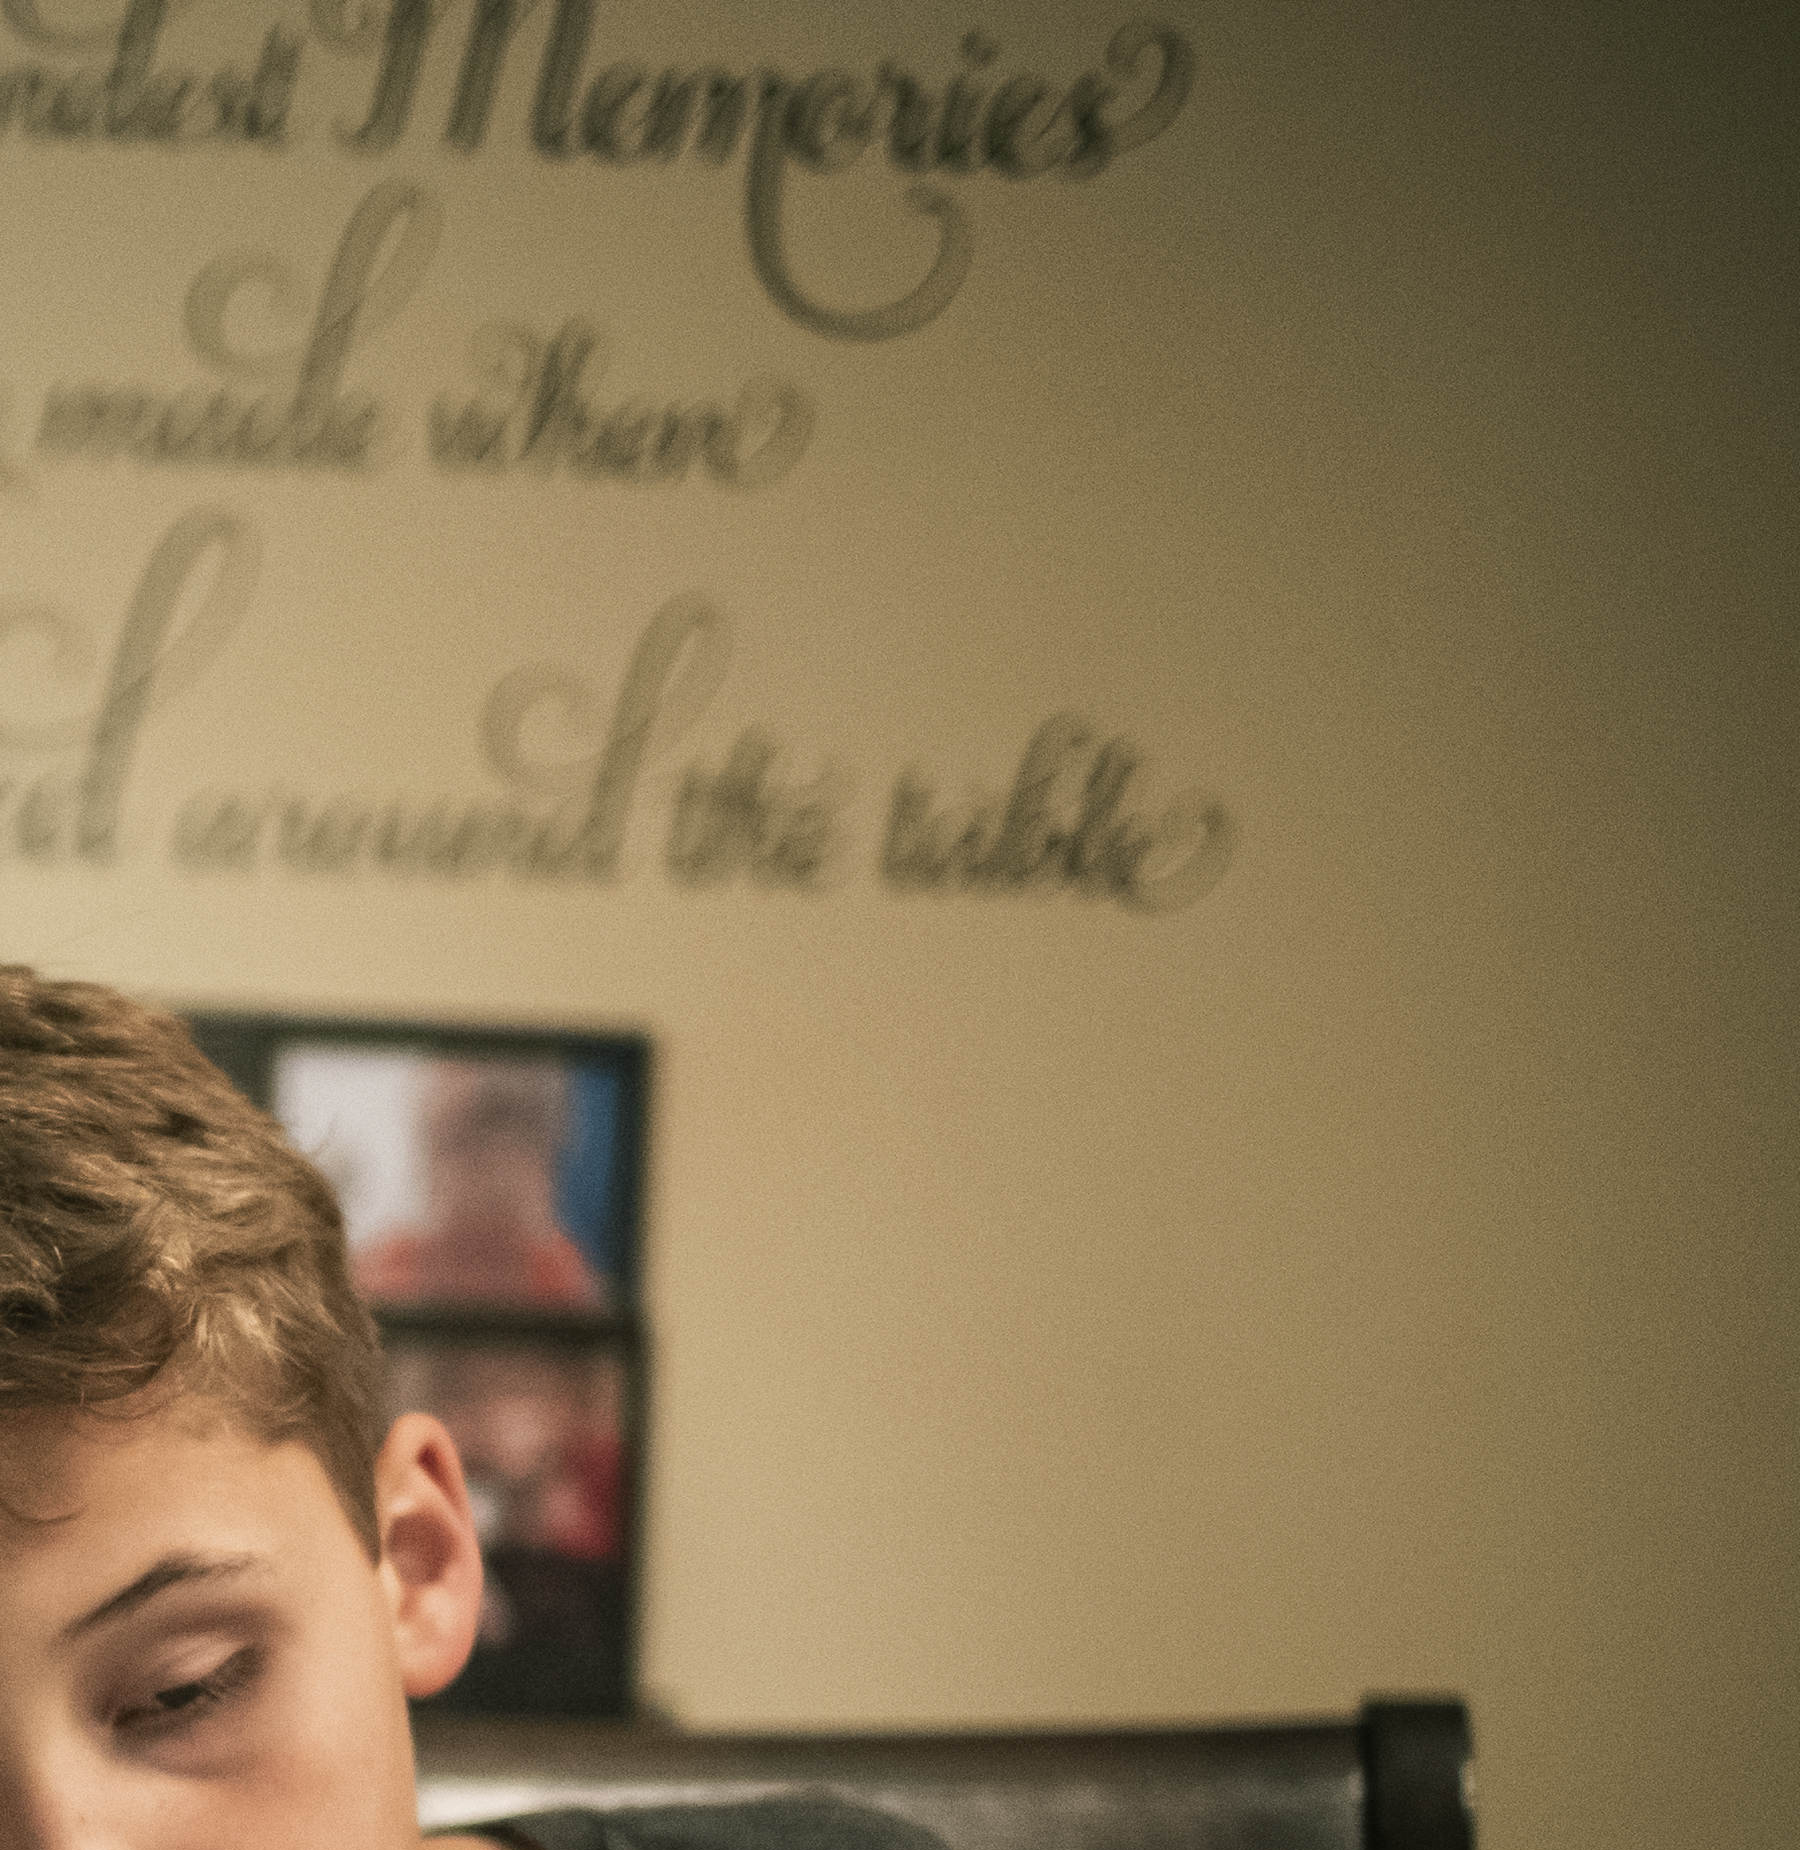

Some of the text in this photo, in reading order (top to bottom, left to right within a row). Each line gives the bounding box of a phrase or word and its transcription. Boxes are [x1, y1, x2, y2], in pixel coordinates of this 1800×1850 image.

[32, 178, 444, 475] made
[426, 314, 816, 486] when
[308, 0, 1193, 342] Memories
[170, 588, 734, 884] around
[662, 722, 842, 896] the
[878, 708, 1236, 916] table
